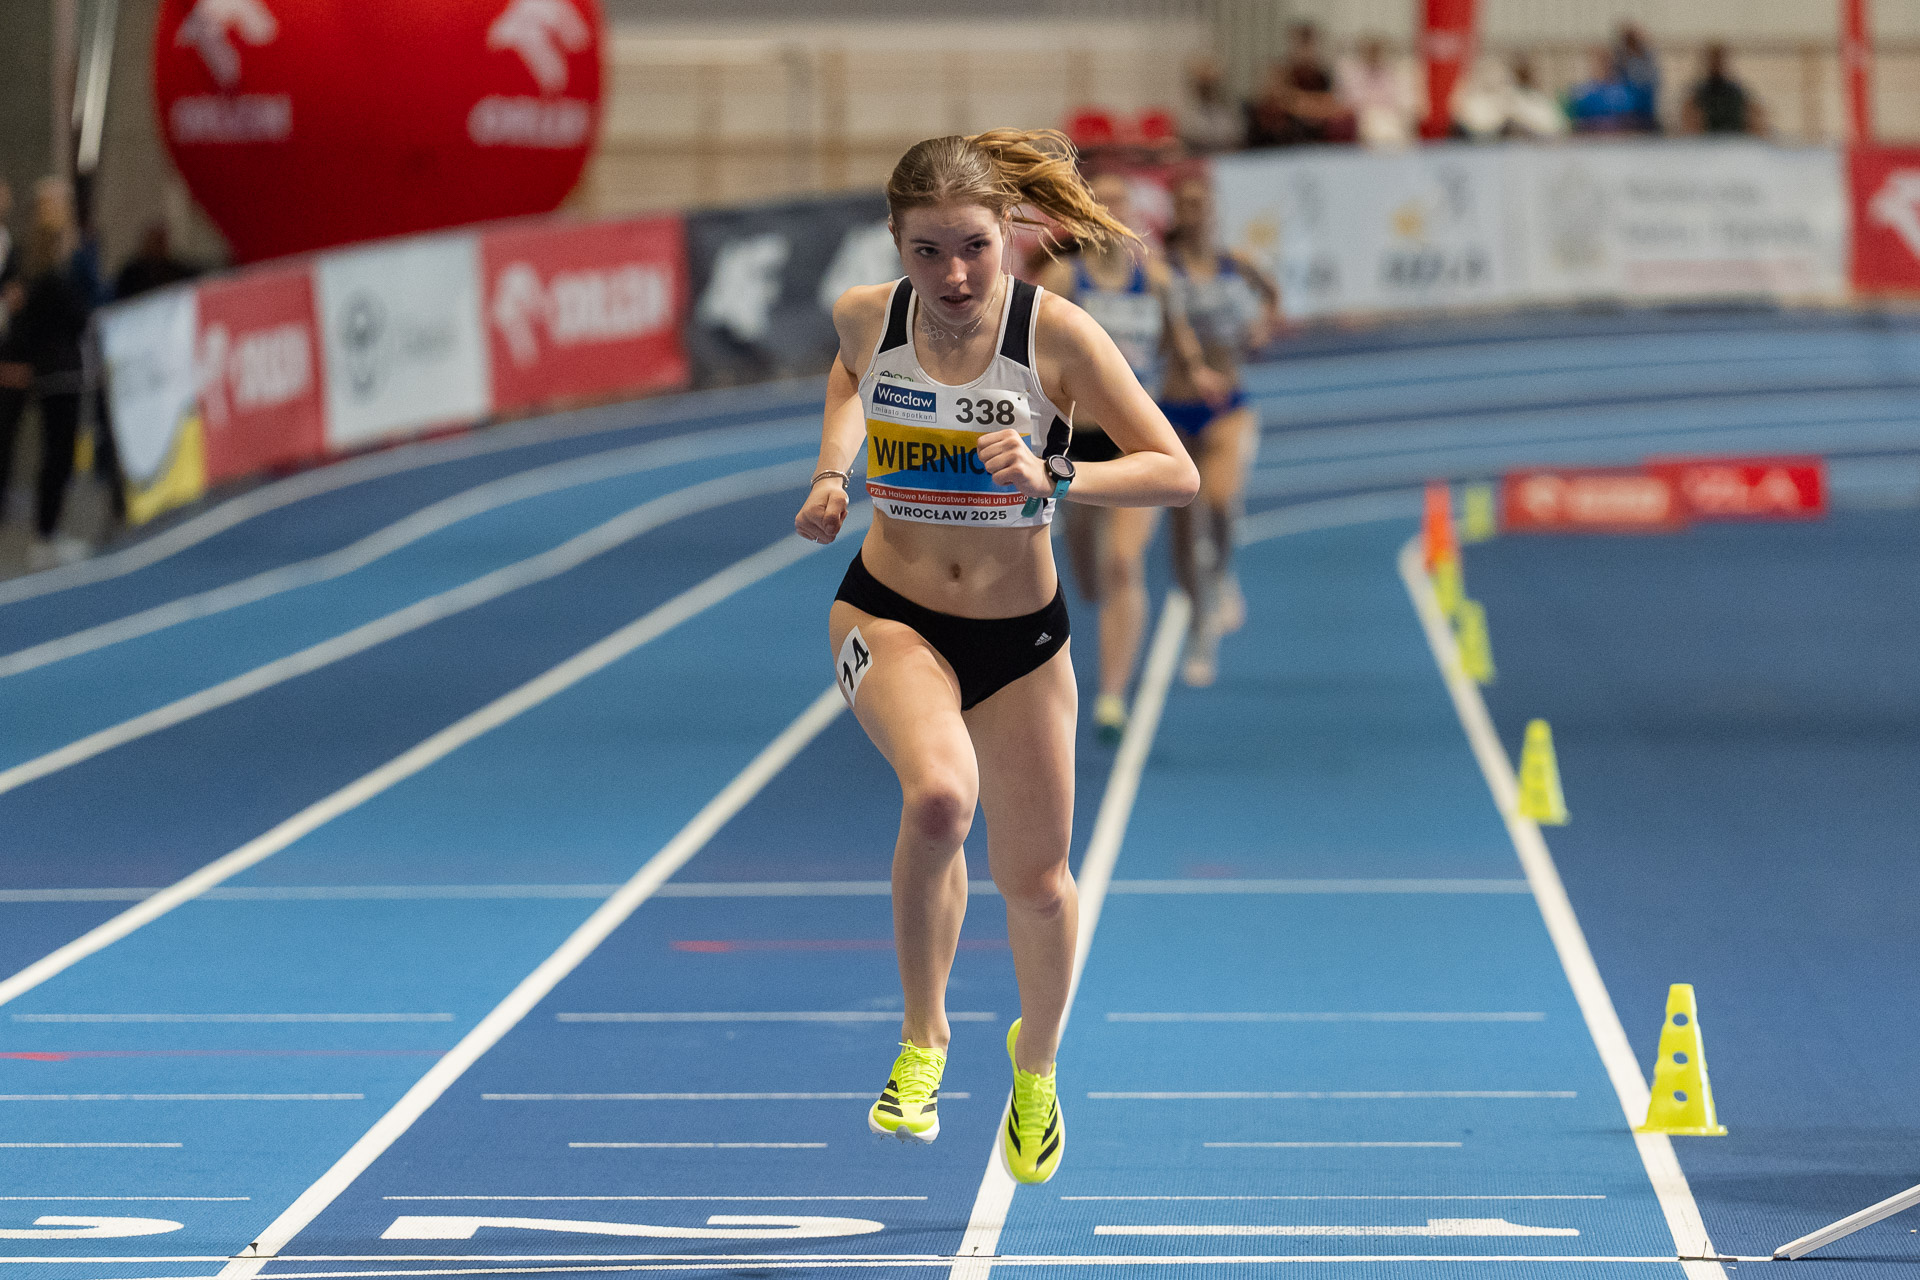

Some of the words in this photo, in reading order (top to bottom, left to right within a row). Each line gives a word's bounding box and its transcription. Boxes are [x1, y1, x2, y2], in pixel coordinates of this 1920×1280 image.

[877, 385, 933, 408] Wrocław
[955, 397, 1016, 425] 338
[873, 435, 993, 475] WIERNIC
[870, 487, 887, 497] PZLA
[888, 491, 917, 501] Halowe
[917, 493, 966, 504] Mistrzostwa
[967, 497, 992, 505] Polski
[993, 497, 1007, 505] U18
[889, 504, 968, 521] WROCŁAW
[971, 510, 1007, 521] 2025
[842, 636, 870, 692] 14
